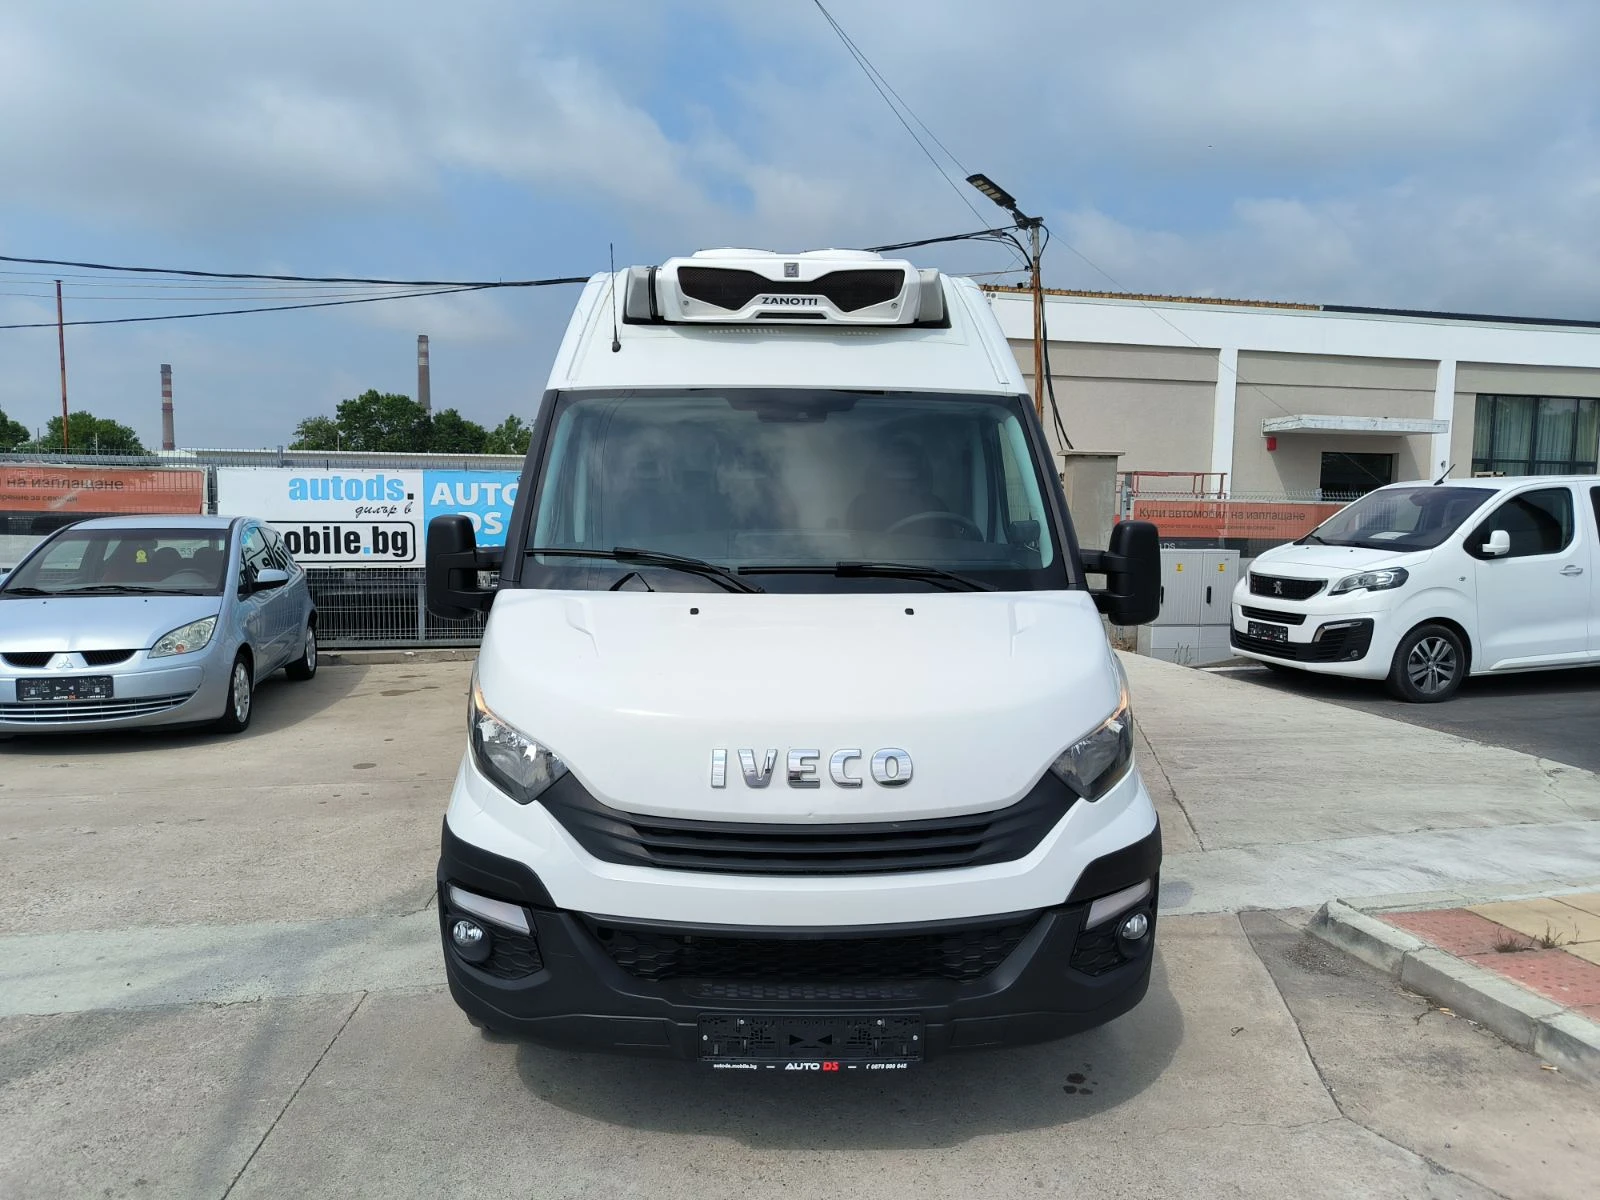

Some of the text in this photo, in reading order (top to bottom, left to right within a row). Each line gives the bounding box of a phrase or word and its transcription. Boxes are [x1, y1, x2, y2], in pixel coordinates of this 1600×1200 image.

[761, 297, 818, 306] ZANOTTI
[7, 479, 124, 491] на изплащане
[355, 505, 397, 518] дилър
[1139, 508, 1306, 522] Купи автомобил на изплащане
[284, 526, 407, 558] obile.bg
[711, 748, 914, 789] IVECO
[785, 1062, 820, 1070] AUTO
[823, 1062, 839, 1070] DS
